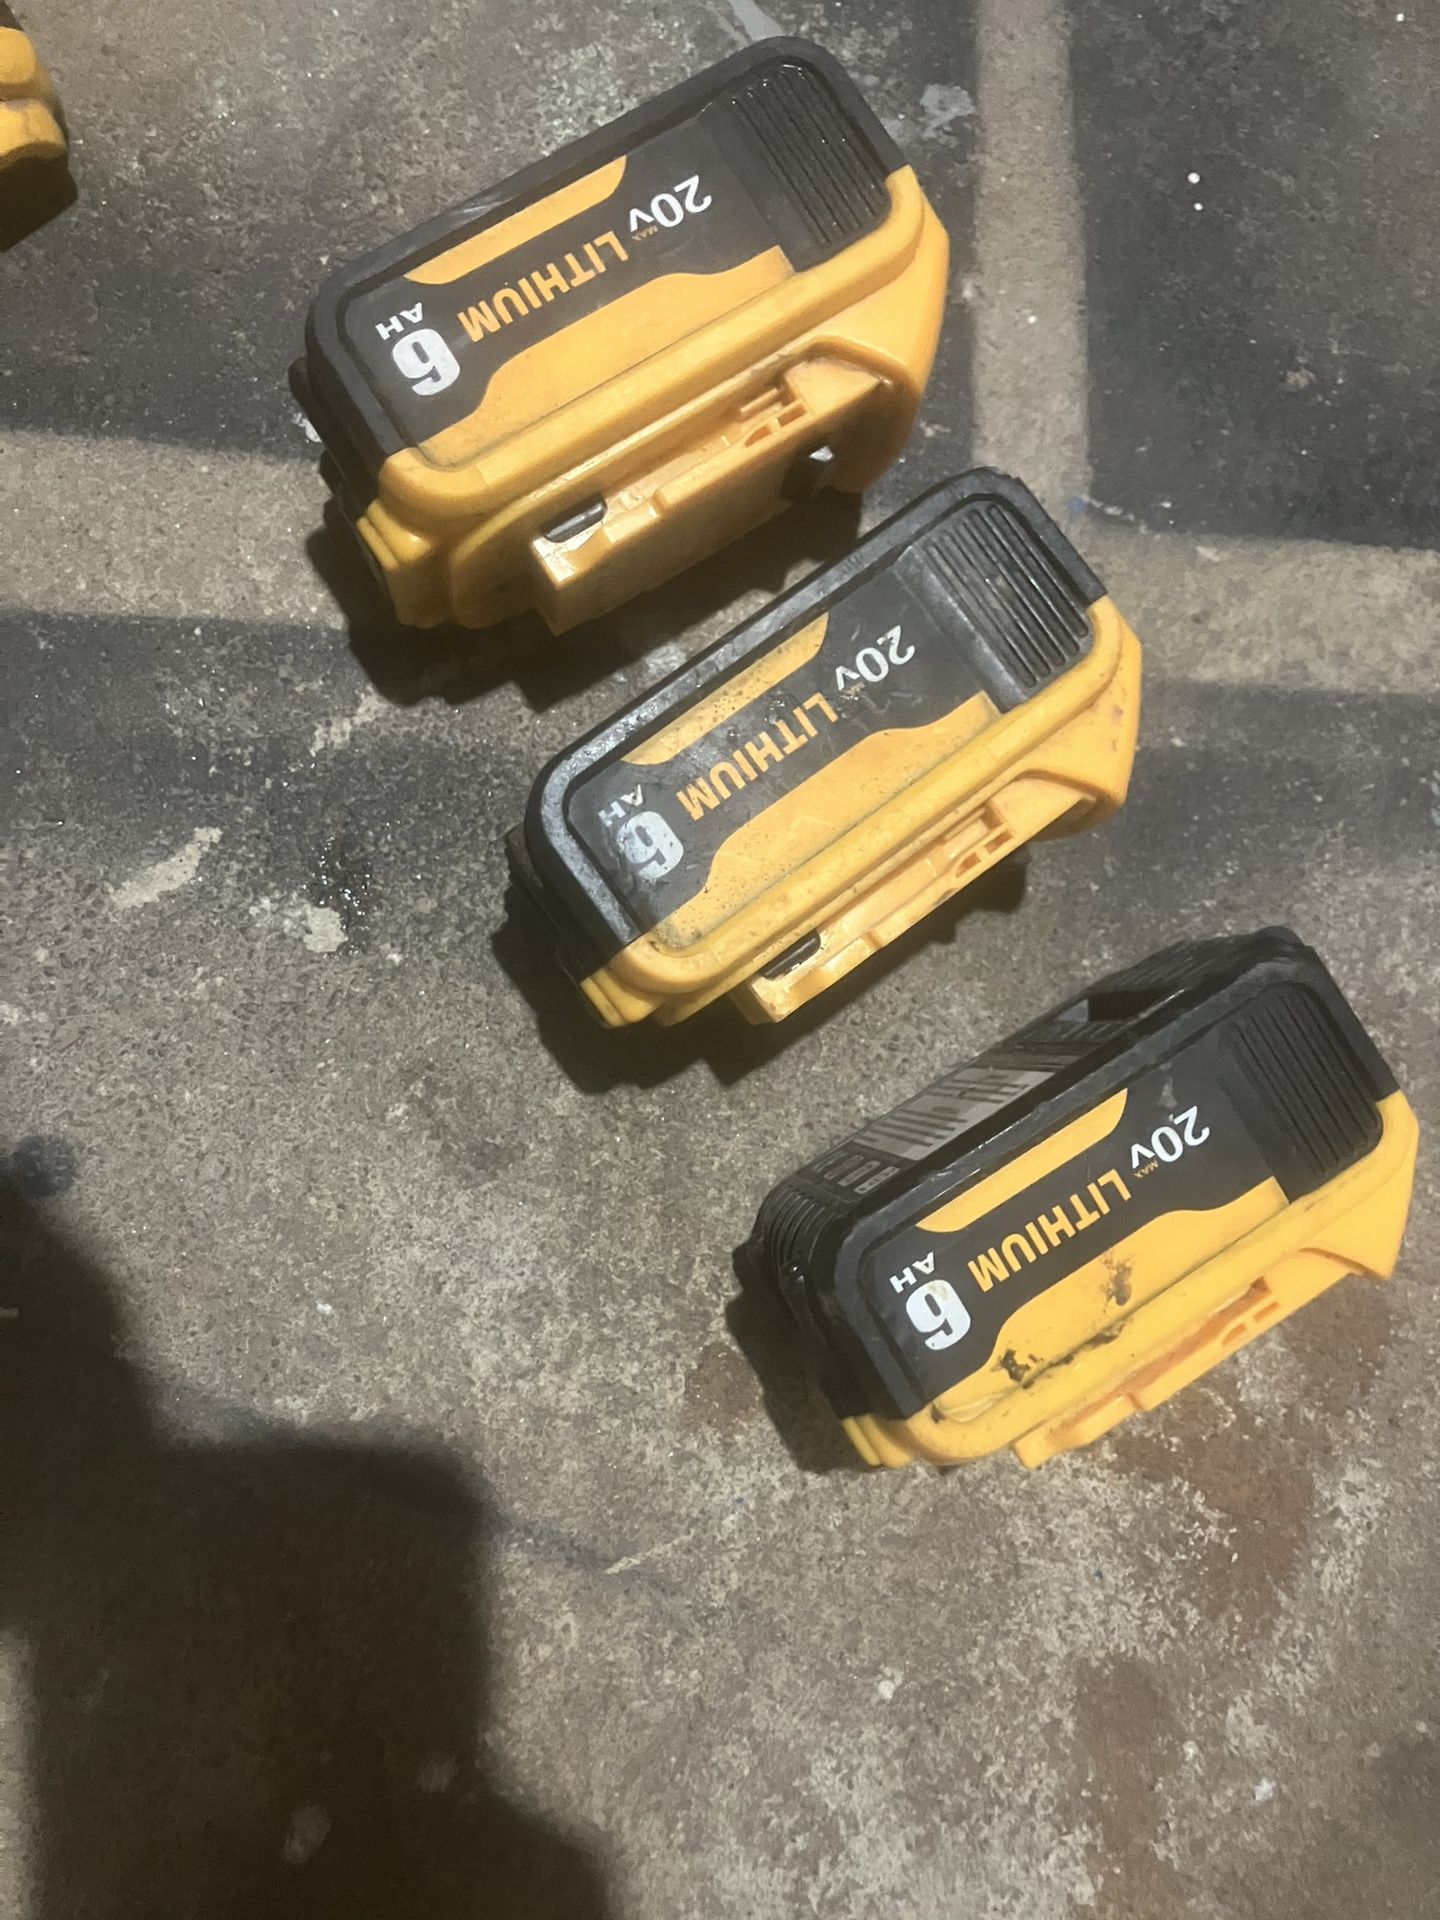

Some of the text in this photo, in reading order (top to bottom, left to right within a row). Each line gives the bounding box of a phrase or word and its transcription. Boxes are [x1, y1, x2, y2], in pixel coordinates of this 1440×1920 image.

[457, 230, 629, 343] LITHIUM
[375, 302, 423, 340] AH
[392, 328, 461, 396] 6
[676, 692, 838, 821] LITHIUM
[598, 784, 643, 827] AH
[617, 811, 684, 879] 6
[1134, 1159, 1159, 1178] MAX
[967, 1169, 1131, 1293] LITHIUM
[889, 1251, 936, 1293] AH
[906, 1279, 971, 1350] 6
